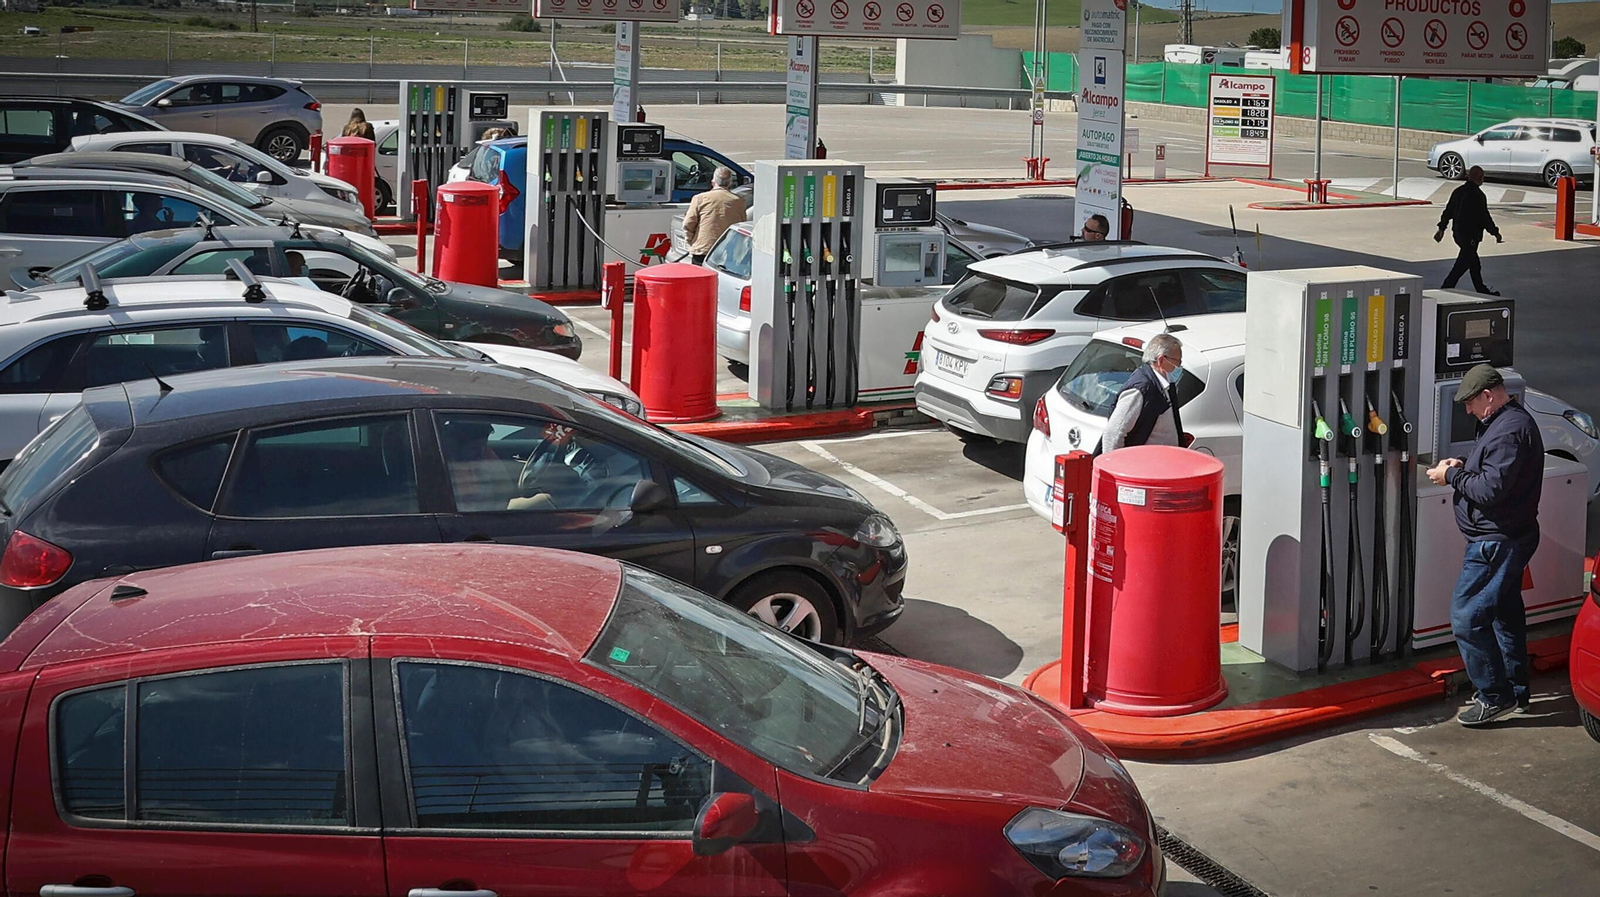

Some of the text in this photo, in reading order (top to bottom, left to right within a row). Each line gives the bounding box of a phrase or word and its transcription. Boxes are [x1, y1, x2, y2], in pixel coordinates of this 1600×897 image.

[1384, 0, 1481, 16] PRODUCTOS
[1303, 47, 1311, 65] 8
[1219, 79, 1265, 91] Alcampo
[1081, 87, 1119, 108] Alcampo
[1247, 109, 1265, 117] 1828
[1082, 129, 1115, 142] AUTOPAGO
[1324, 313, 1329, 321] 98
[1350, 312, 1356, 320] 95
[954, 360, 968, 373] KPV
